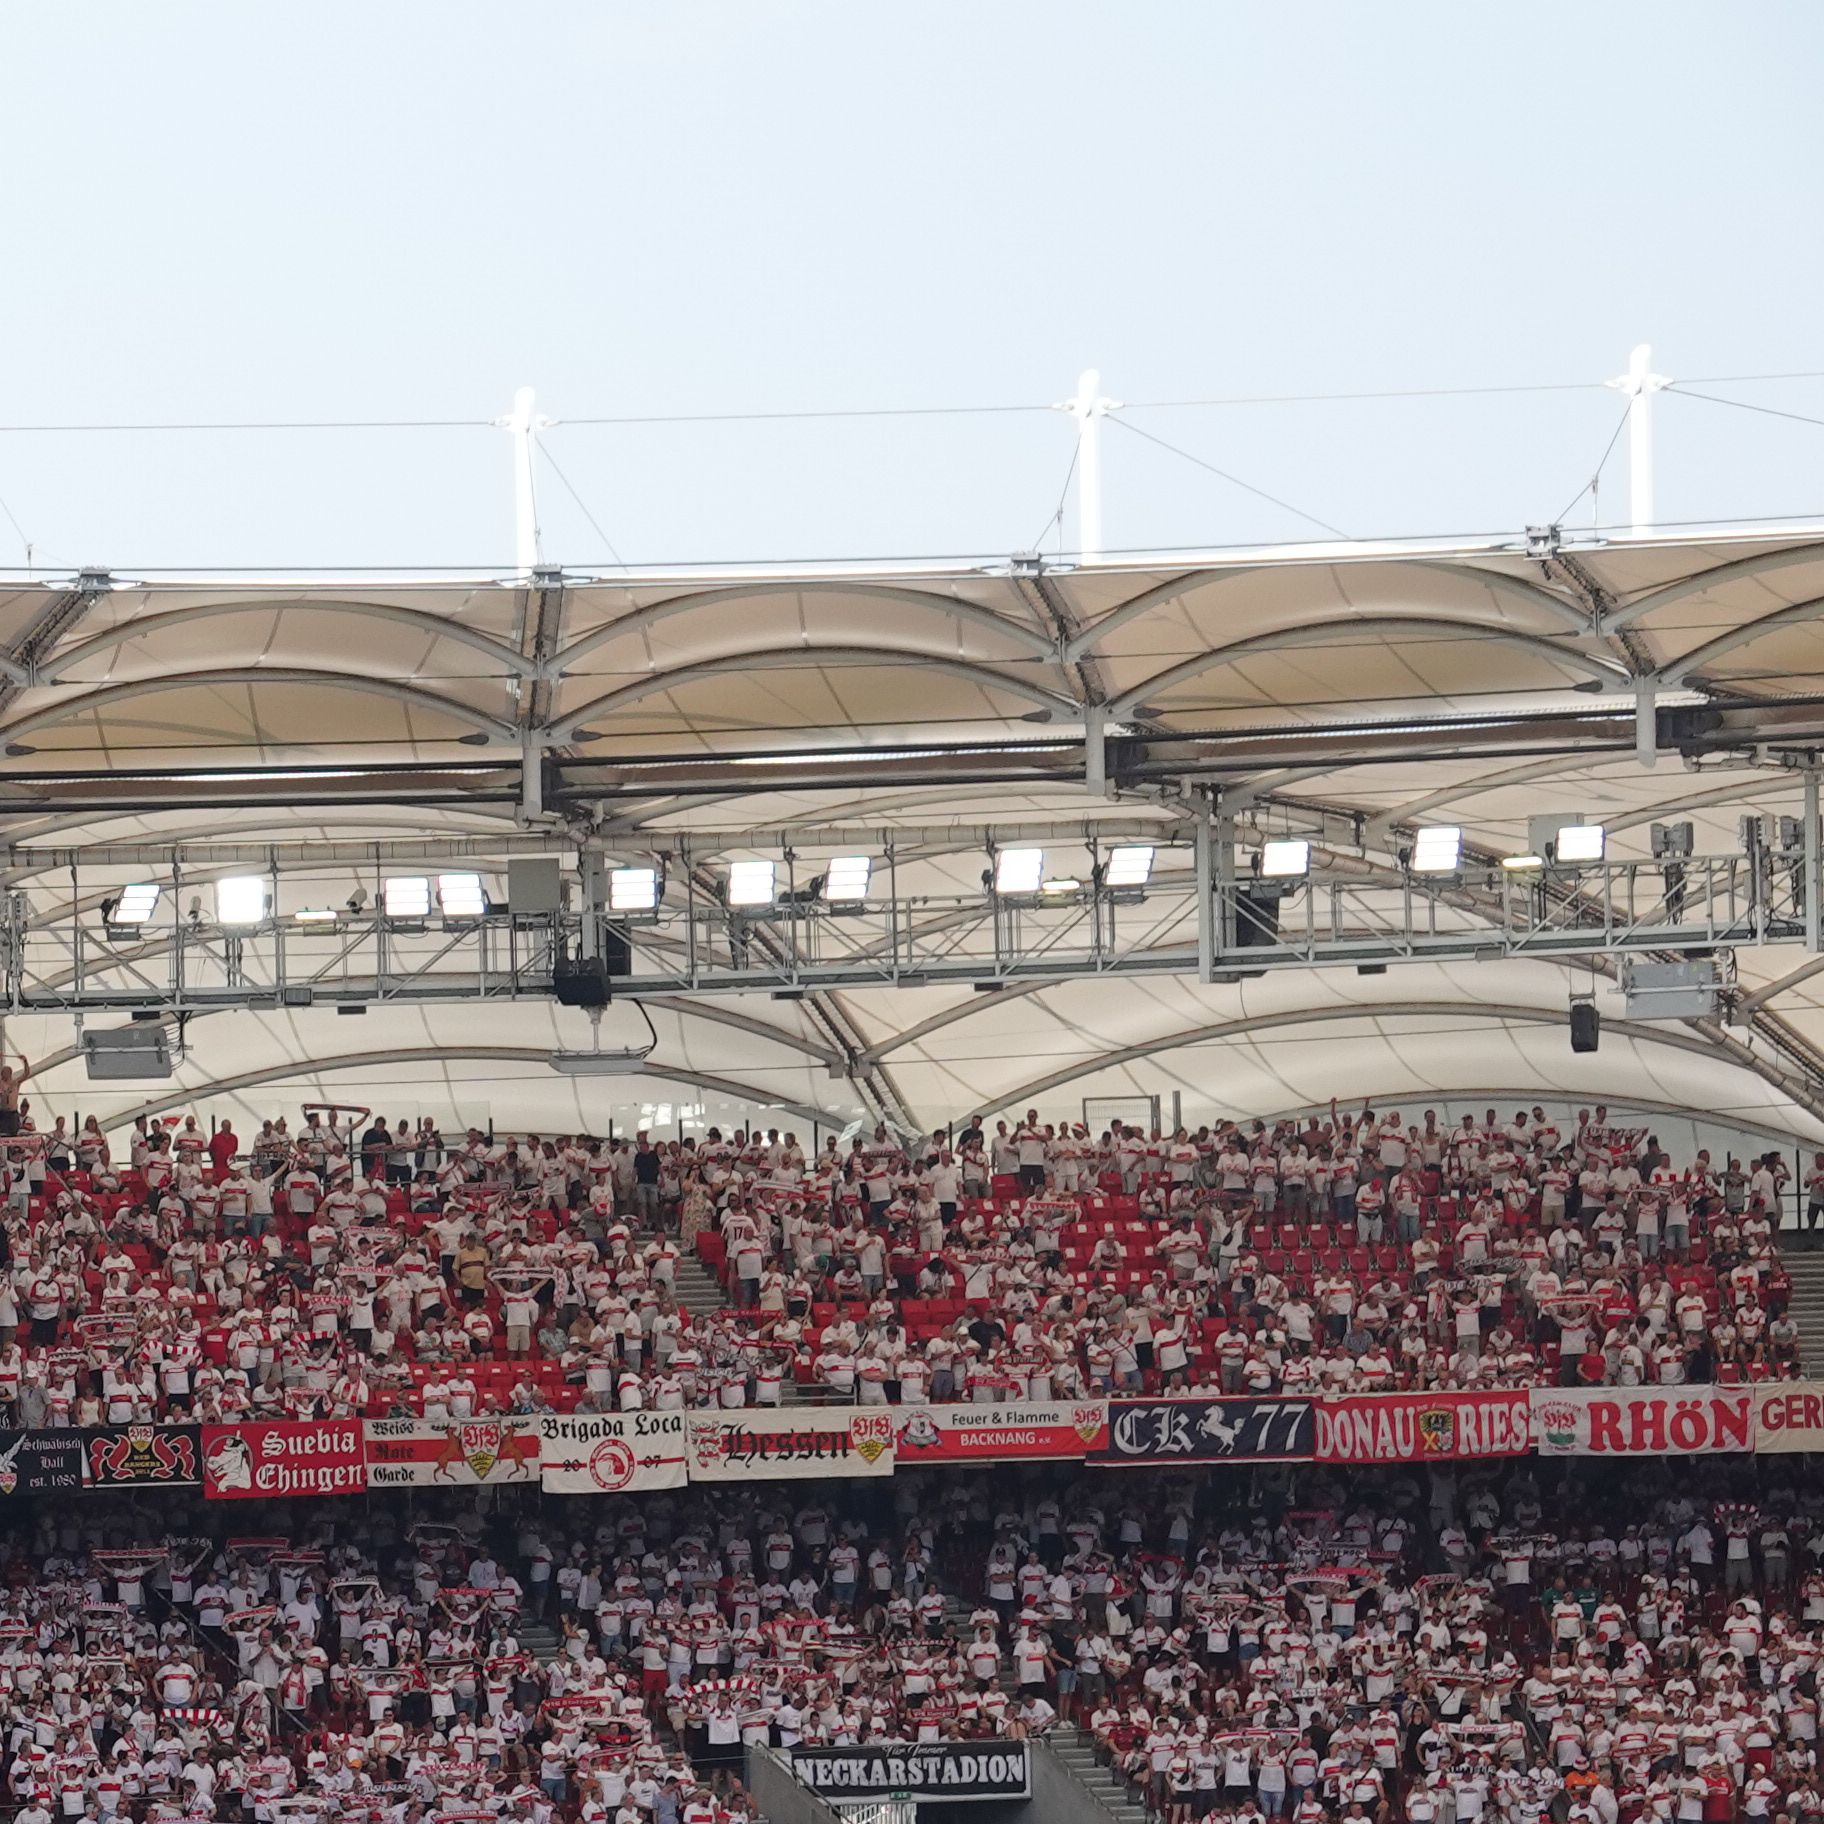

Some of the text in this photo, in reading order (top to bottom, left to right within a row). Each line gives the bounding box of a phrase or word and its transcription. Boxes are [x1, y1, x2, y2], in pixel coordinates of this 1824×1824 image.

[541, 1411, 683, 1445] Brigada Loca
[951, 1410, 1060, 1426] Feuer & Flamme
[1114, 1402, 1311, 1456] CK 77
[1316, 1400, 1529, 1459] DONAU RIES
[1586, 1399, 1751, 1452] RHÖN
[261, 1429, 357, 1458] Suebia
[721, 1422, 853, 1464] Hessen
[959, 1431, 1037, 1447] BACKNANG
[255, 1458, 364, 1490] Ehingen
[372, 1466, 415, 1483] Garde
[792, 1752, 1025, 1787] NECKARSTADION
